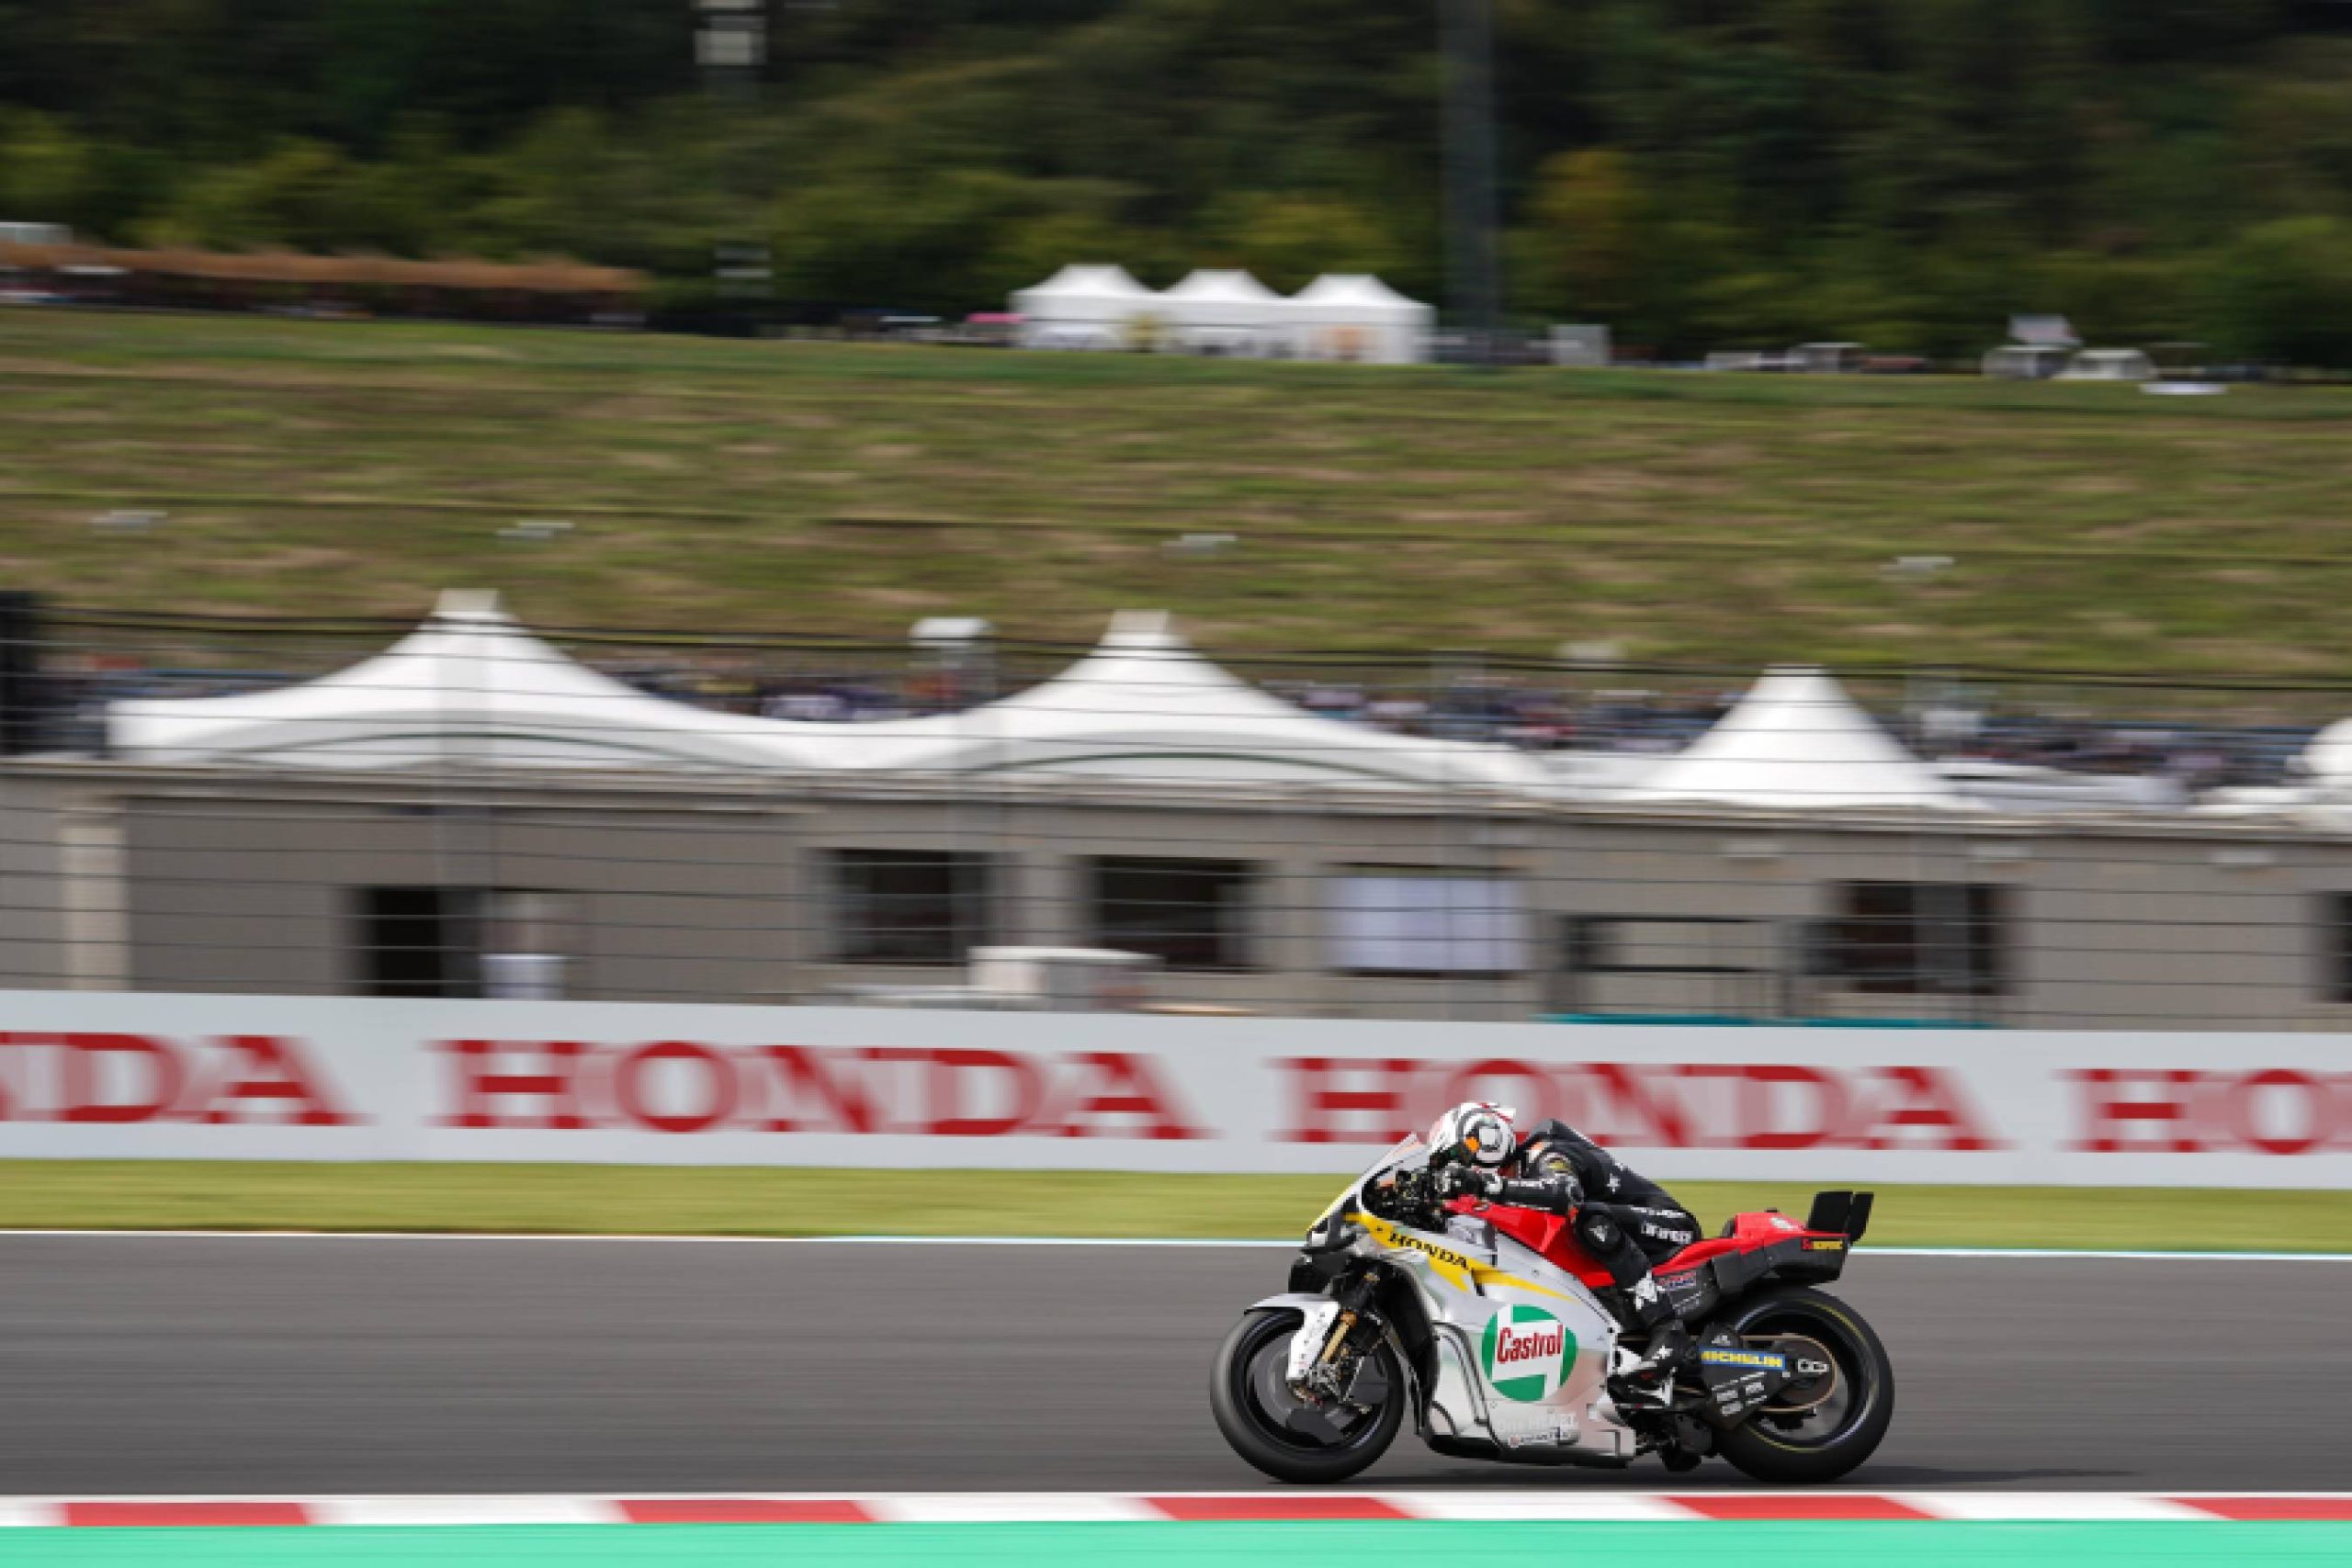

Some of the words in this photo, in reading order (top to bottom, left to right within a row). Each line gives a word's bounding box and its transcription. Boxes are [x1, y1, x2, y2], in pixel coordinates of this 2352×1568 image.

[427, 1038, 1213, 1141] HONDA
[1272, 1055, 1996, 1152] HONDA
[2058, 1066, 2352, 1156] HO
[1387, 1232, 1470, 1271] HONDA
[1497, 1324, 1564, 1365] Castrol
[1700, 1349, 1784, 1369] MICHELIN
